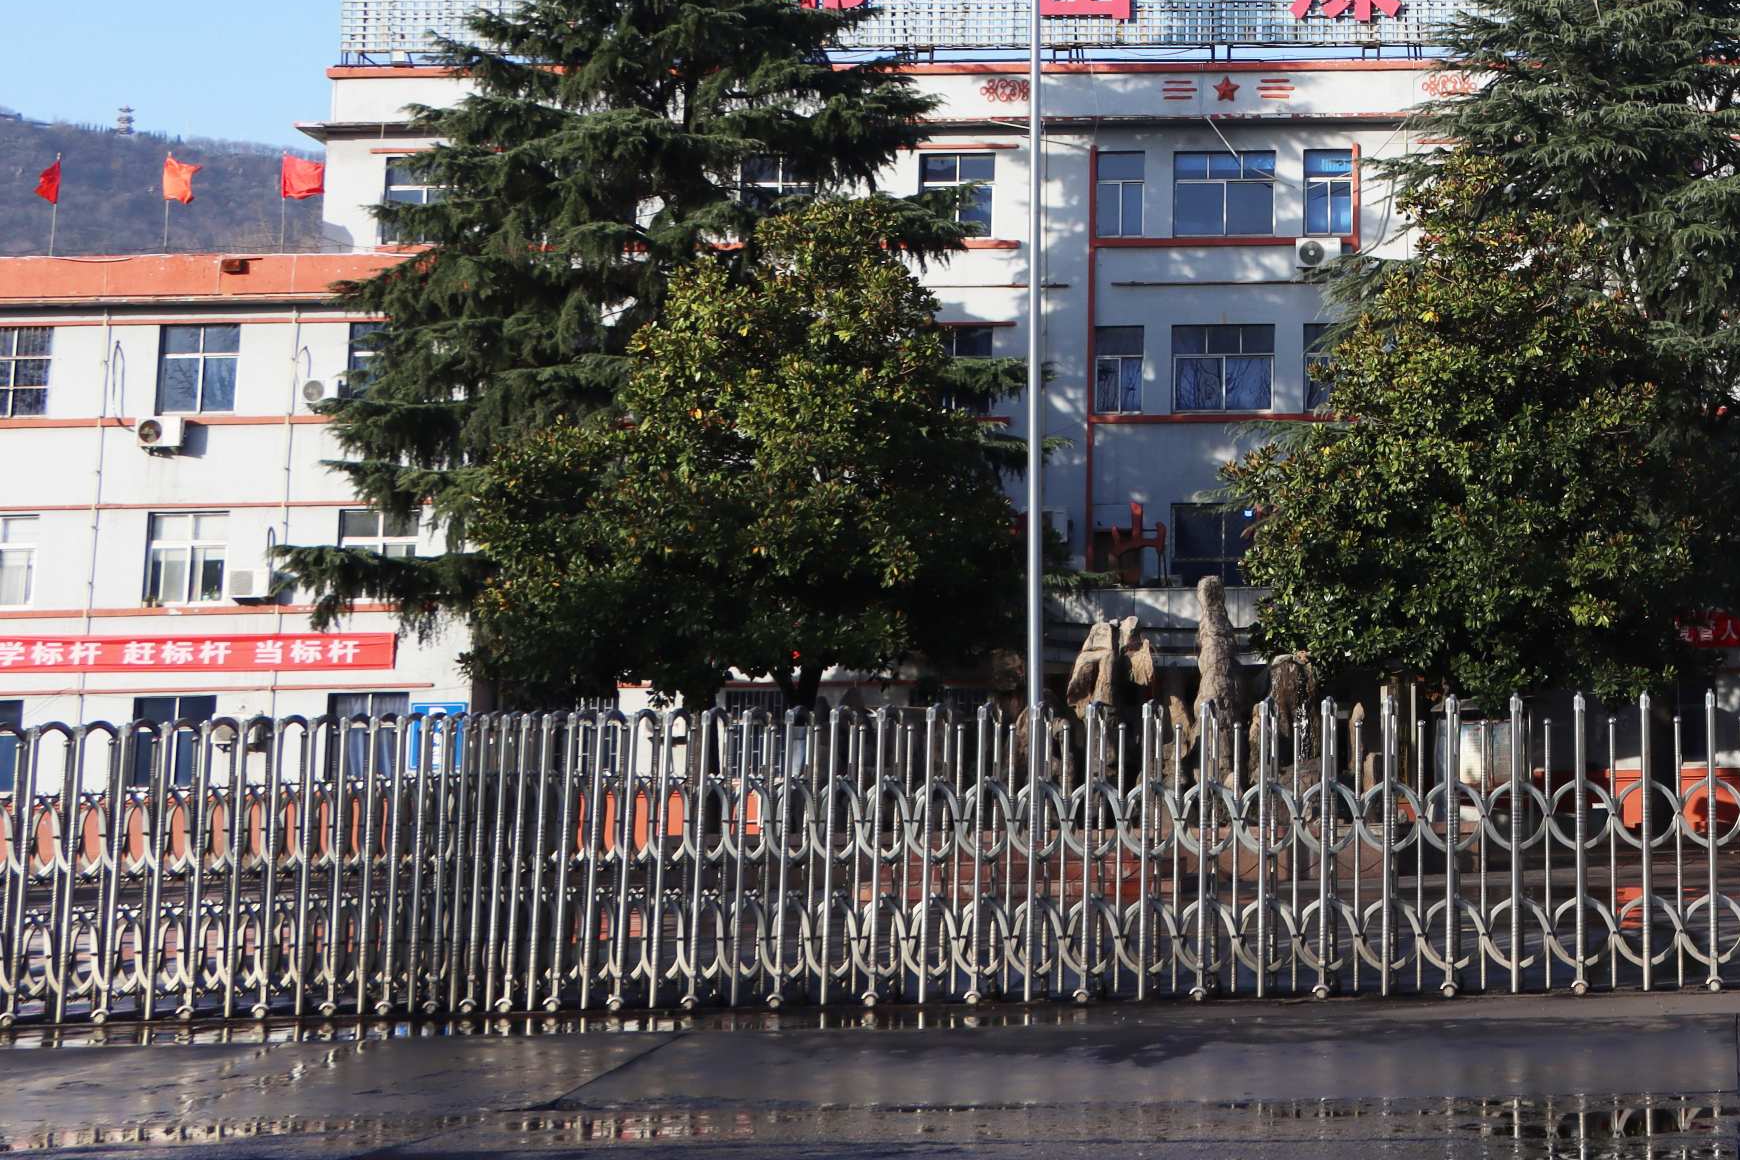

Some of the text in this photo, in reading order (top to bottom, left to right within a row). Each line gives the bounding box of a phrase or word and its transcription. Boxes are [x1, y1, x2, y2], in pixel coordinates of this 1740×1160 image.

[0, 639, 361, 667] 学标杆 赶标杆 当标杆
